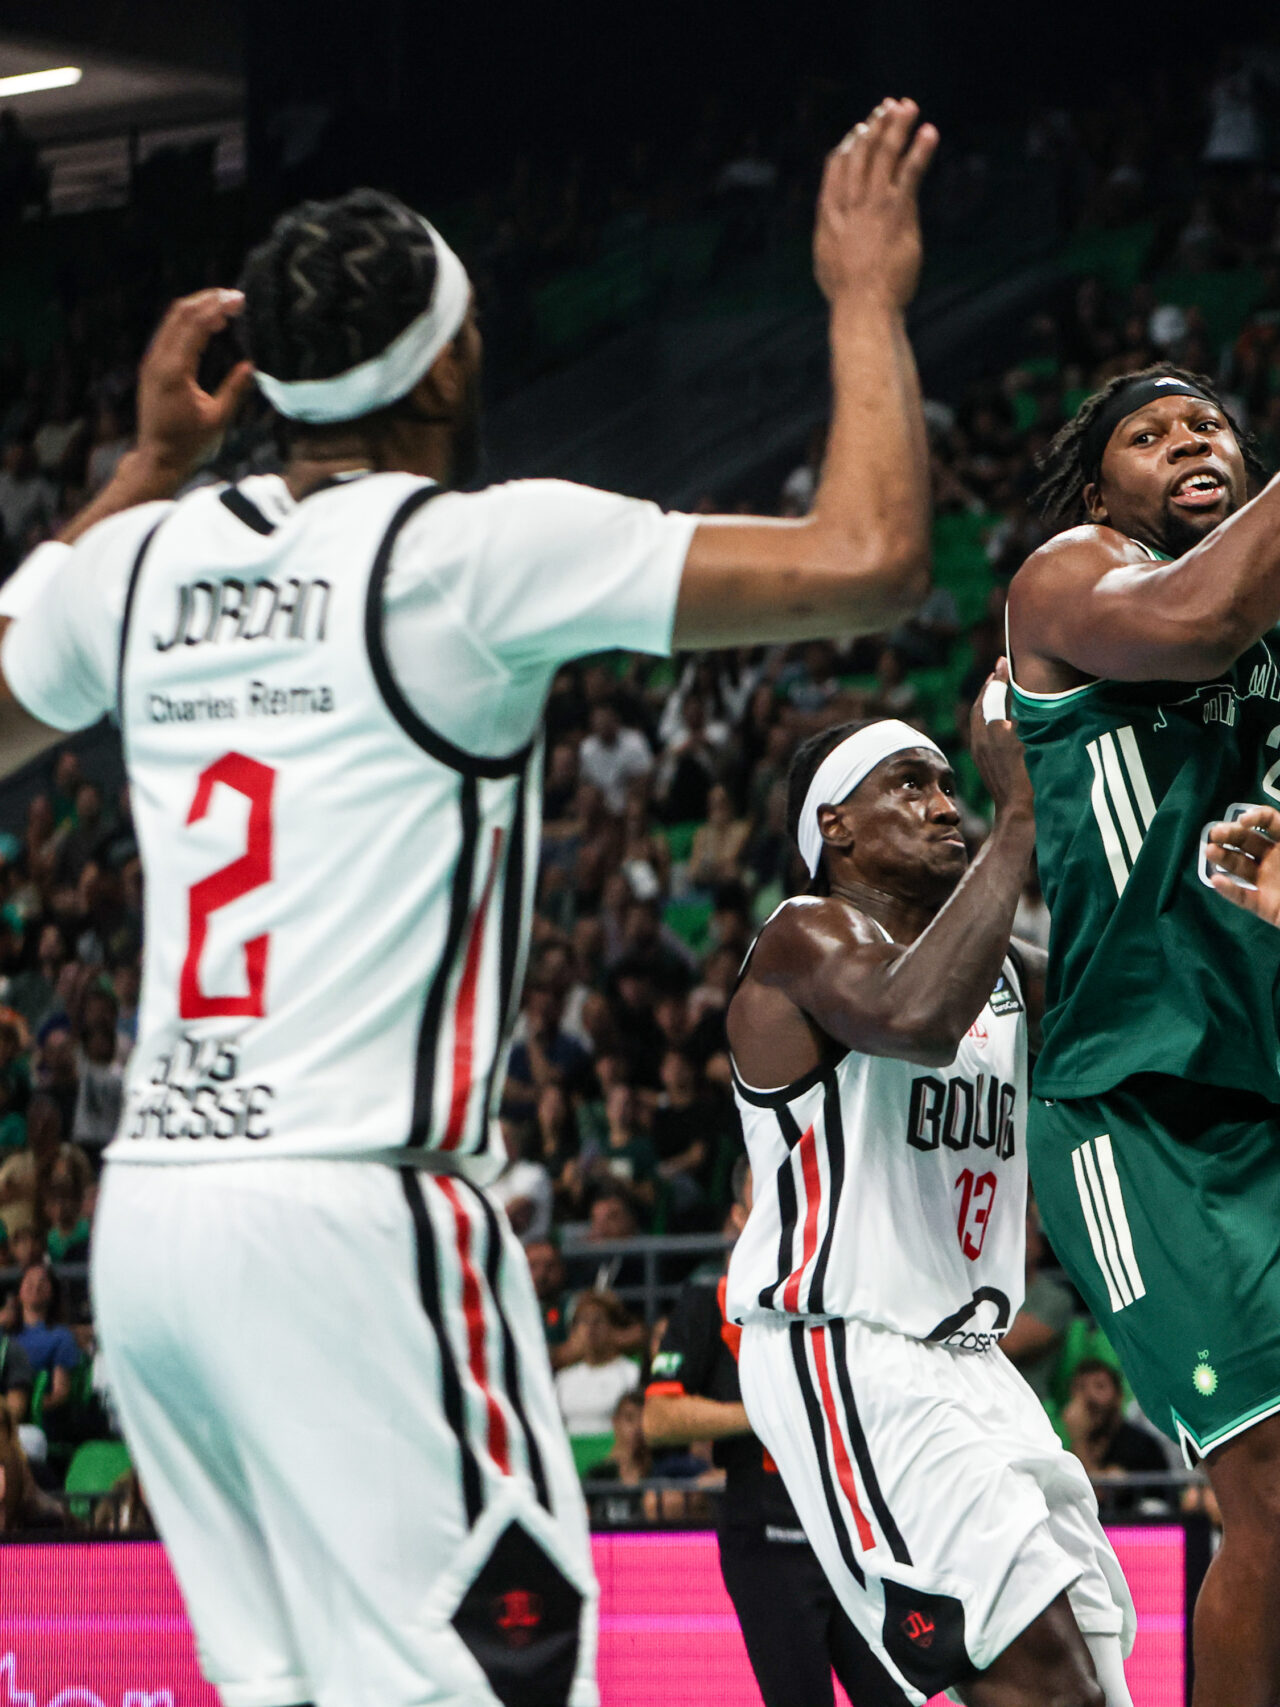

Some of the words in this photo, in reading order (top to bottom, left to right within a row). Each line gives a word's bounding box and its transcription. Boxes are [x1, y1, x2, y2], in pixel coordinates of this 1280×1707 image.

[152, 574, 331, 652] JORDAN
[147, 692, 237, 723] Charles
[179, 750, 277, 1019] 2
[954, 1167, 998, 1262] 13
[906, 1611, 935, 1639] JL
